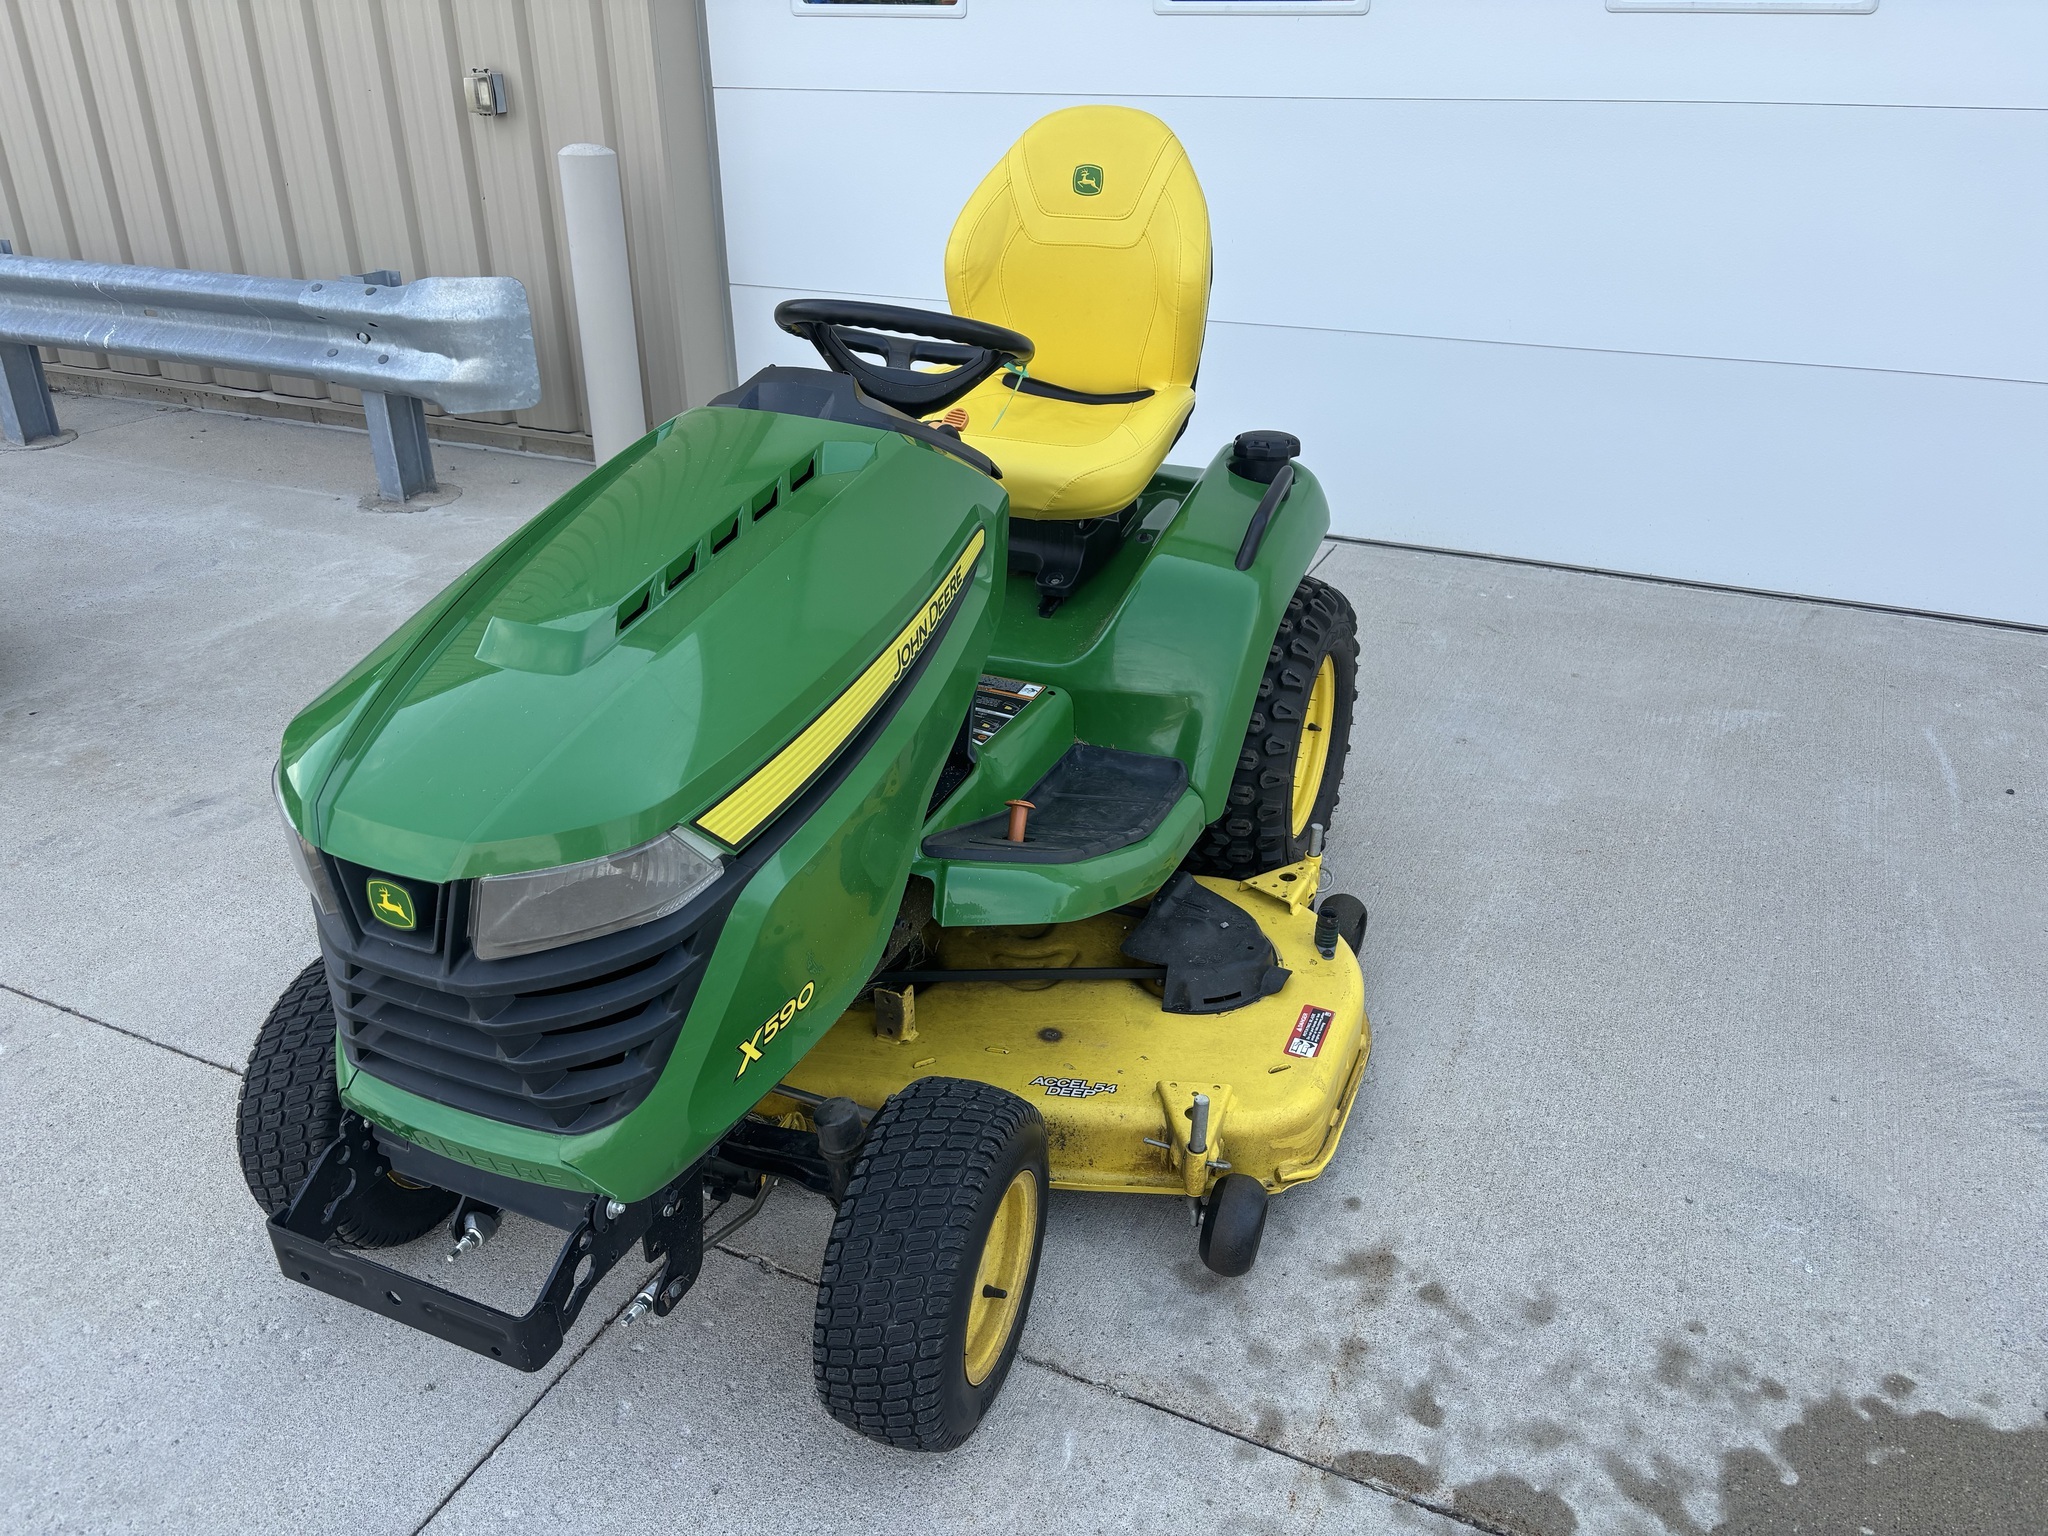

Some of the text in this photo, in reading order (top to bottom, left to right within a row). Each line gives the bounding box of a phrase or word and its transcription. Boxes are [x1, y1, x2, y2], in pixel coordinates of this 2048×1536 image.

[894, 565, 963, 679] JOHN DEERE
[734, 980, 815, 1082] X590
[1028, 1076, 1118, 1094] ACCEL 54
[1045, 1086, 1096, 1098] DEEP
